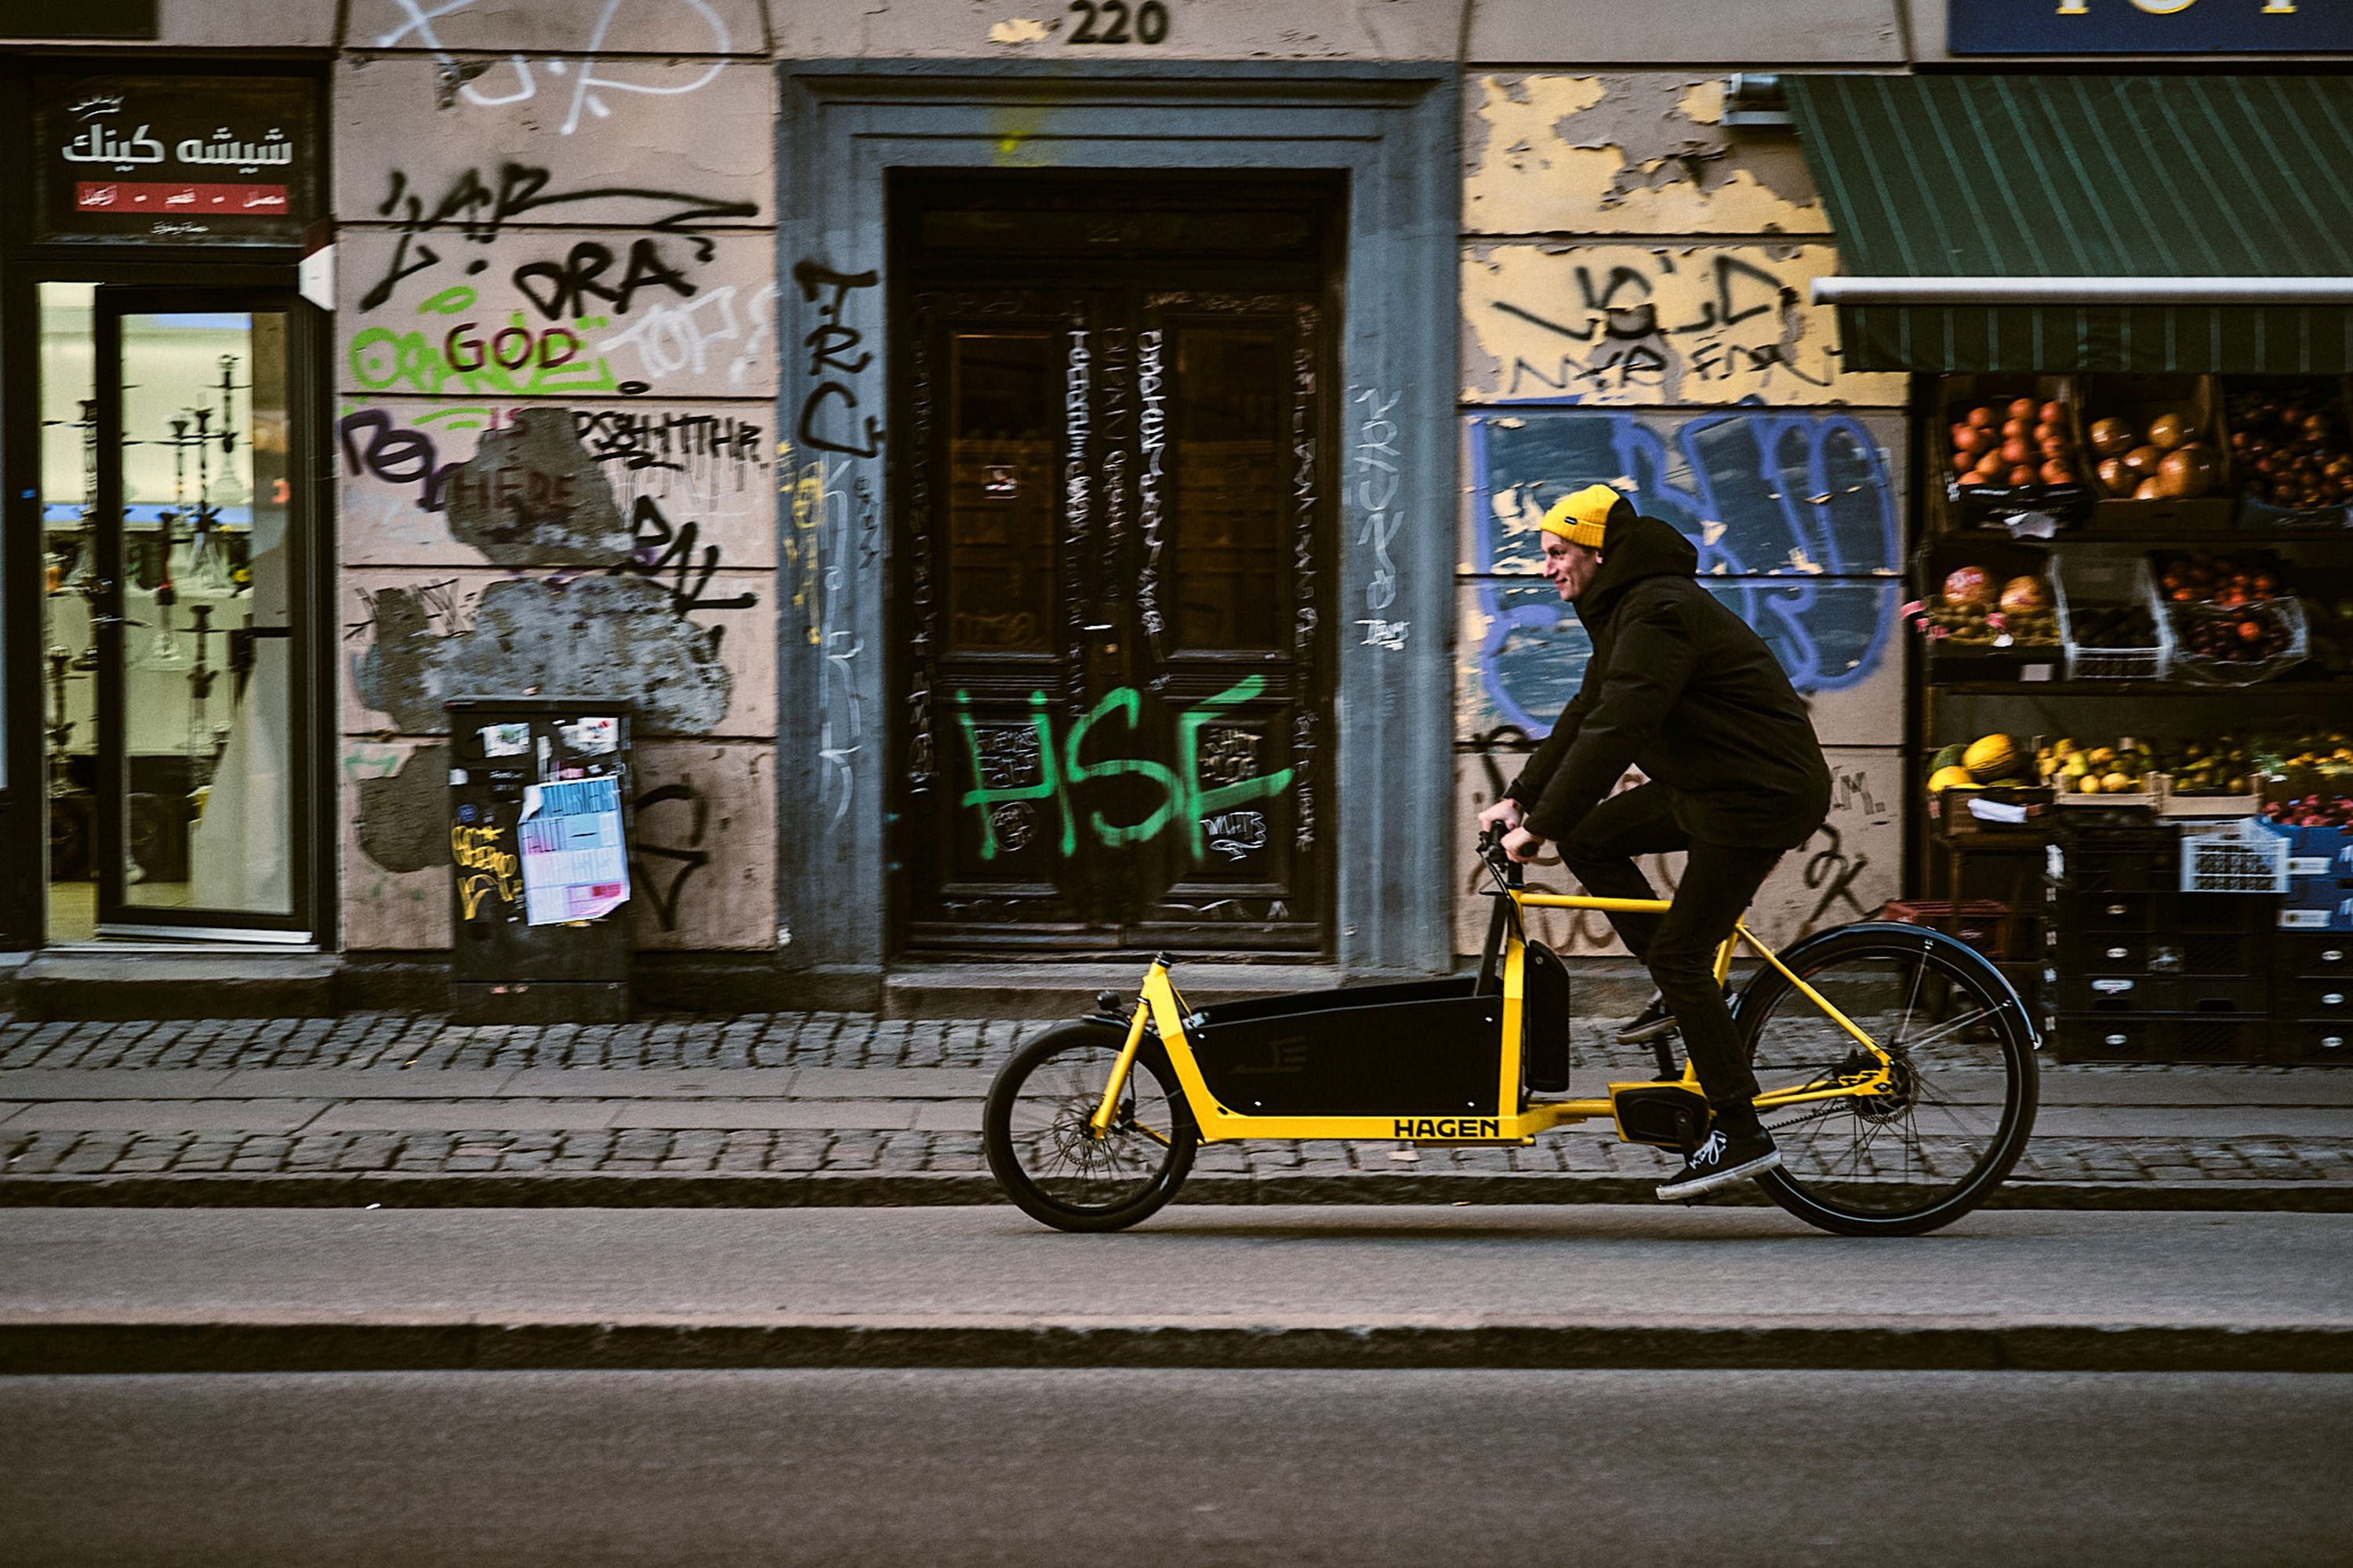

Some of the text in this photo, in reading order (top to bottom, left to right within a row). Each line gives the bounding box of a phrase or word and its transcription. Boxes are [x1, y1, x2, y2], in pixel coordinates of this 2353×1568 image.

[1066, 0, 1169, 45] 220
[445, 322, 580, 372] GOD
[1394, 1119, 1500, 1138] HAGEN
